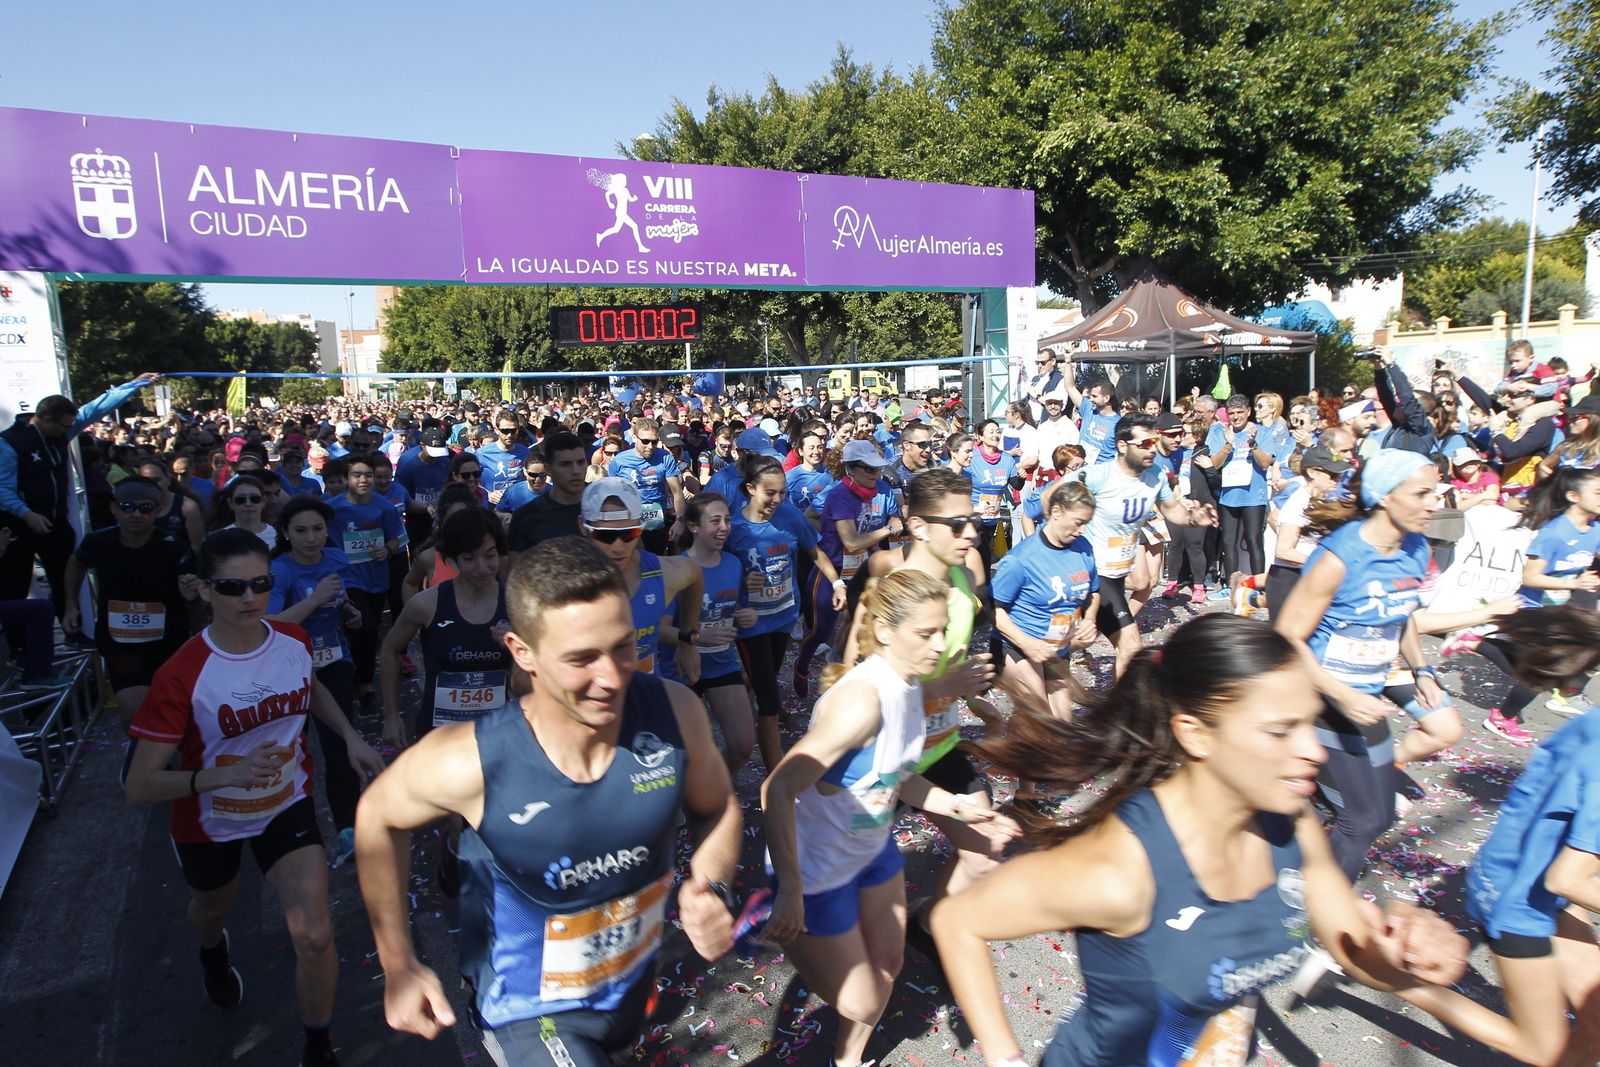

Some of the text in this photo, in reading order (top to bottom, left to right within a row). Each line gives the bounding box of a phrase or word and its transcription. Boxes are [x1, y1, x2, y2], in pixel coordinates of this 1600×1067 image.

[188, 165, 410, 213] ALMERÍA
[643, 176, 693, 200] VIII
[645, 203, 696, 214] CARRERA
[190, 210, 307, 238] CIUDAD
[477, 257, 797, 277] LA IGUALDAD ES NUESTRA META.
[122, 614, 150, 625] 385
[456, 652, 501, 660] DEHARO
[449, 688, 493, 704] 1546
[559, 846, 650, 890] DEHARO
